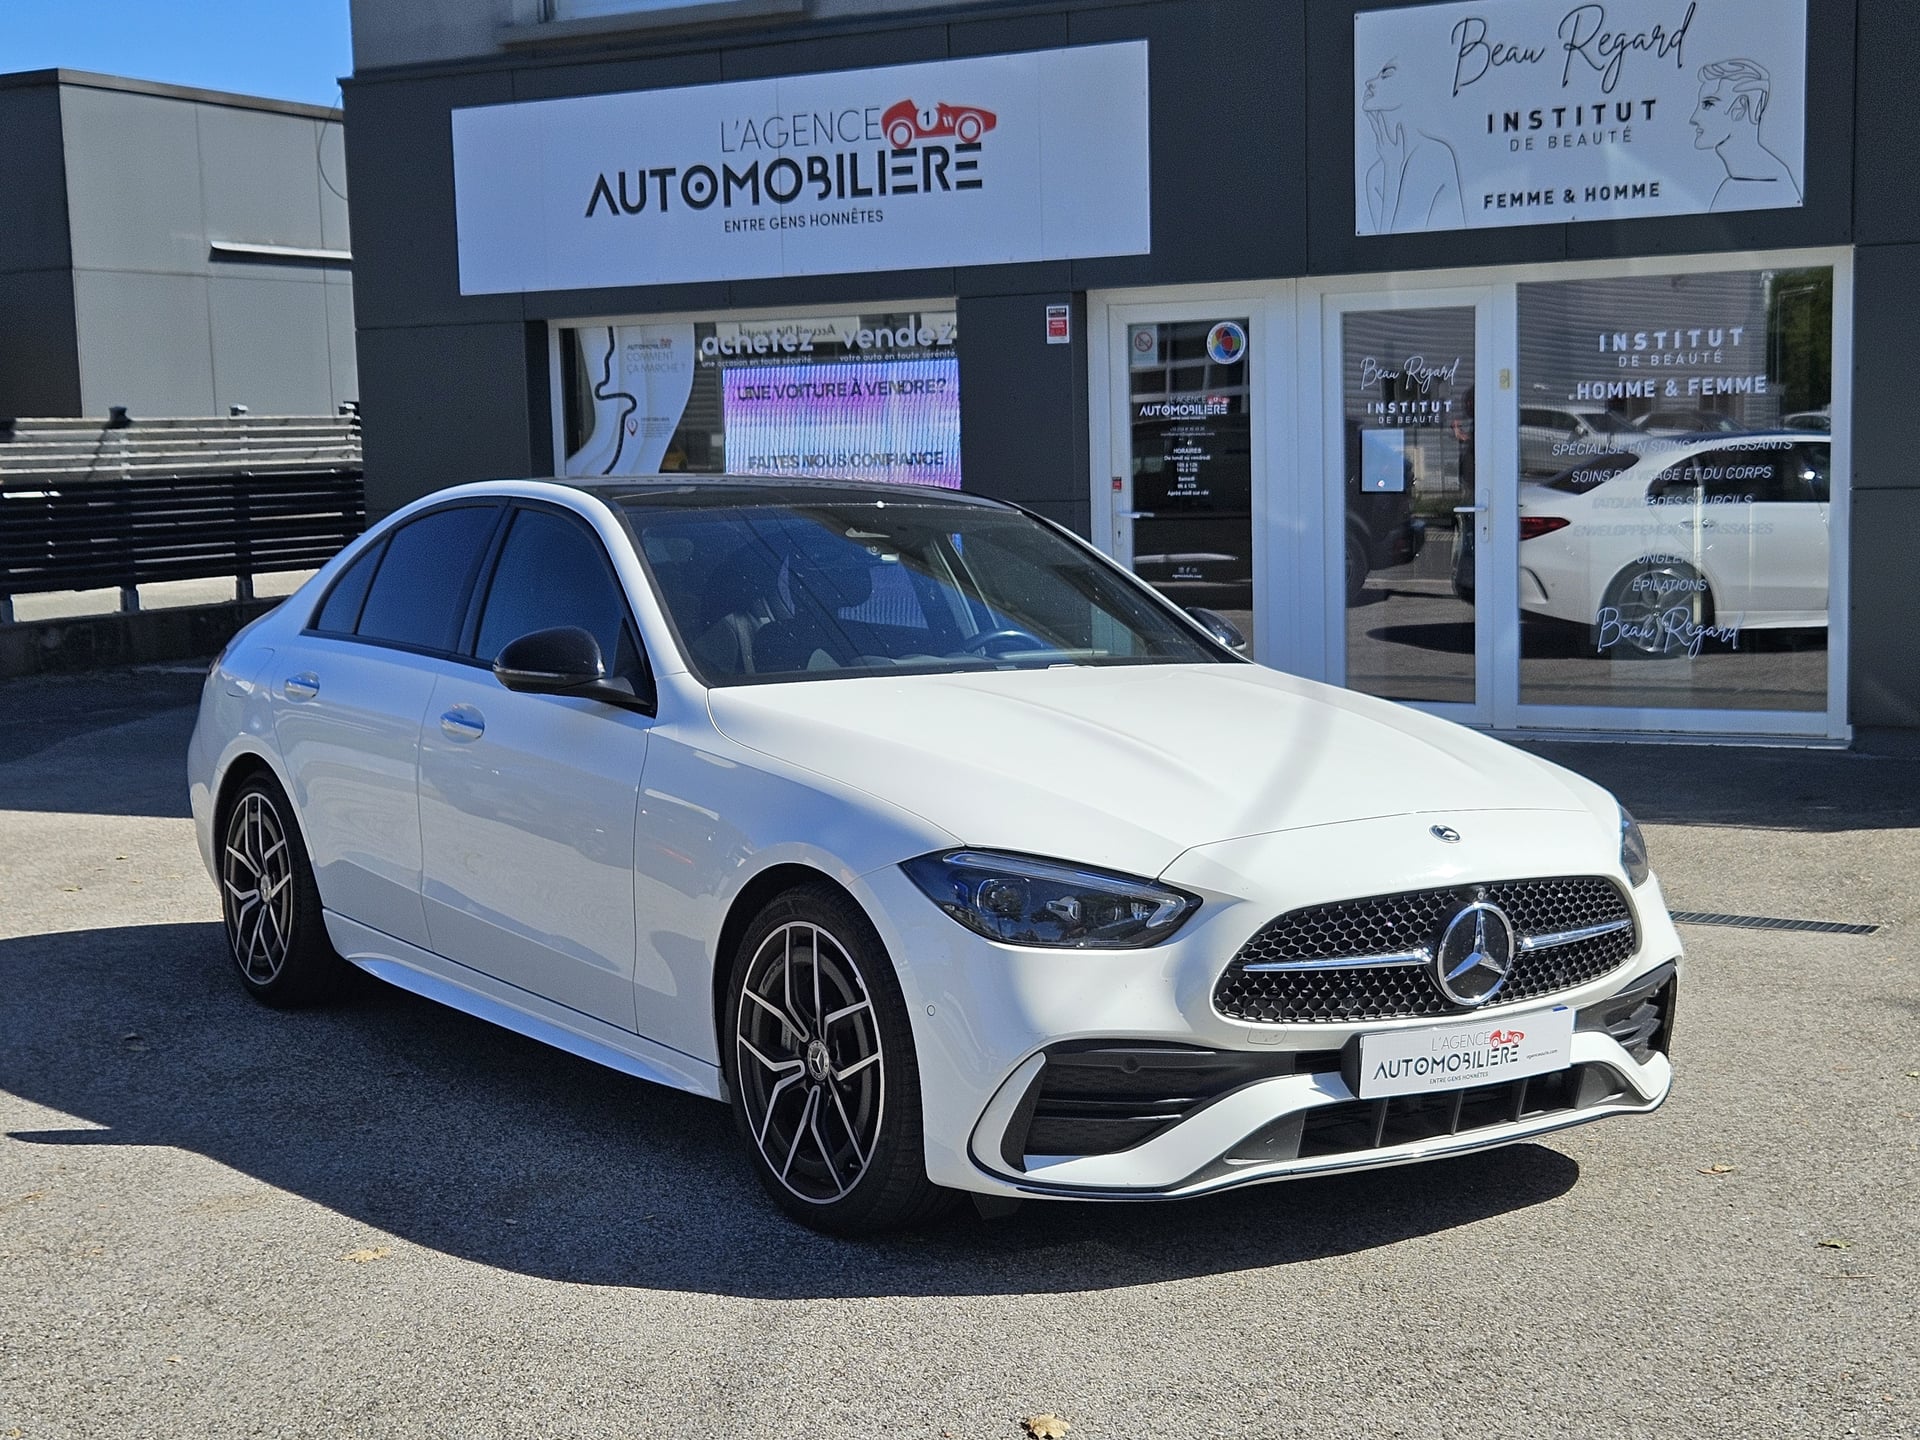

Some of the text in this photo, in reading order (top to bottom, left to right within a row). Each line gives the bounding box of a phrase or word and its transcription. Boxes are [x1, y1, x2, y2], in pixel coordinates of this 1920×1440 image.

[1451, 2, 1695, 97] Beau Regard
[1486, 99, 1657, 134] INSTITUT
[720, 107, 881, 153] L'AGENCE
[1510, 126, 1632, 152] DE BEAUTÉ
[1484, 182, 1660, 210] FEMME & HOMME
[724, 208, 884, 233] ENTRE GENS HONNÊTES
[701, 328, 814, 357] achetez
[843, 314, 954, 350] vendez
[1599, 327, 1744, 352] INSTITUT
[701, 360, 716, 368] une
[717, 358, 747, 368] occasion
[749, 358, 759, 367] en
[760, 357, 780, 366] toute
[839, 348, 958, 362] votre auto en toute sérénité.
[1619, 350, 1723, 367] DE BEAUTÉ
[1360, 355, 1460, 394] Beau Regard
[737, 385, 771, 401] UNE
[774, 382, 847, 399] VOITURE
[850, 378, 863, 397] À
[1576, 375, 1767, 400] HOMME & FEMME
[1367, 400, 1452, 414] INSTITUT
[1378, 414, 1440, 424] DE BEAUTÉ
[749, 451, 944, 469] FAITES NOUS CONFIANCE
[1571, 468, 1612, 483] SOINS
[1683, 468, 1700, 480] ET
[1703, 467, 1723, 480] DU
[1725, 465, 1772, 479] CORPS
[1658, 496, 1685, 508] DES
[1686, 495, 1753, 507] SURCILS
[1595, 606, 1745, 659] Beau Regard
[1431, 1031, 1490, 1051] L'AGENCE
[1429, 1076, 1446, 1085] ENTRE
[1447, 1074, 1462, 1083] GENS
